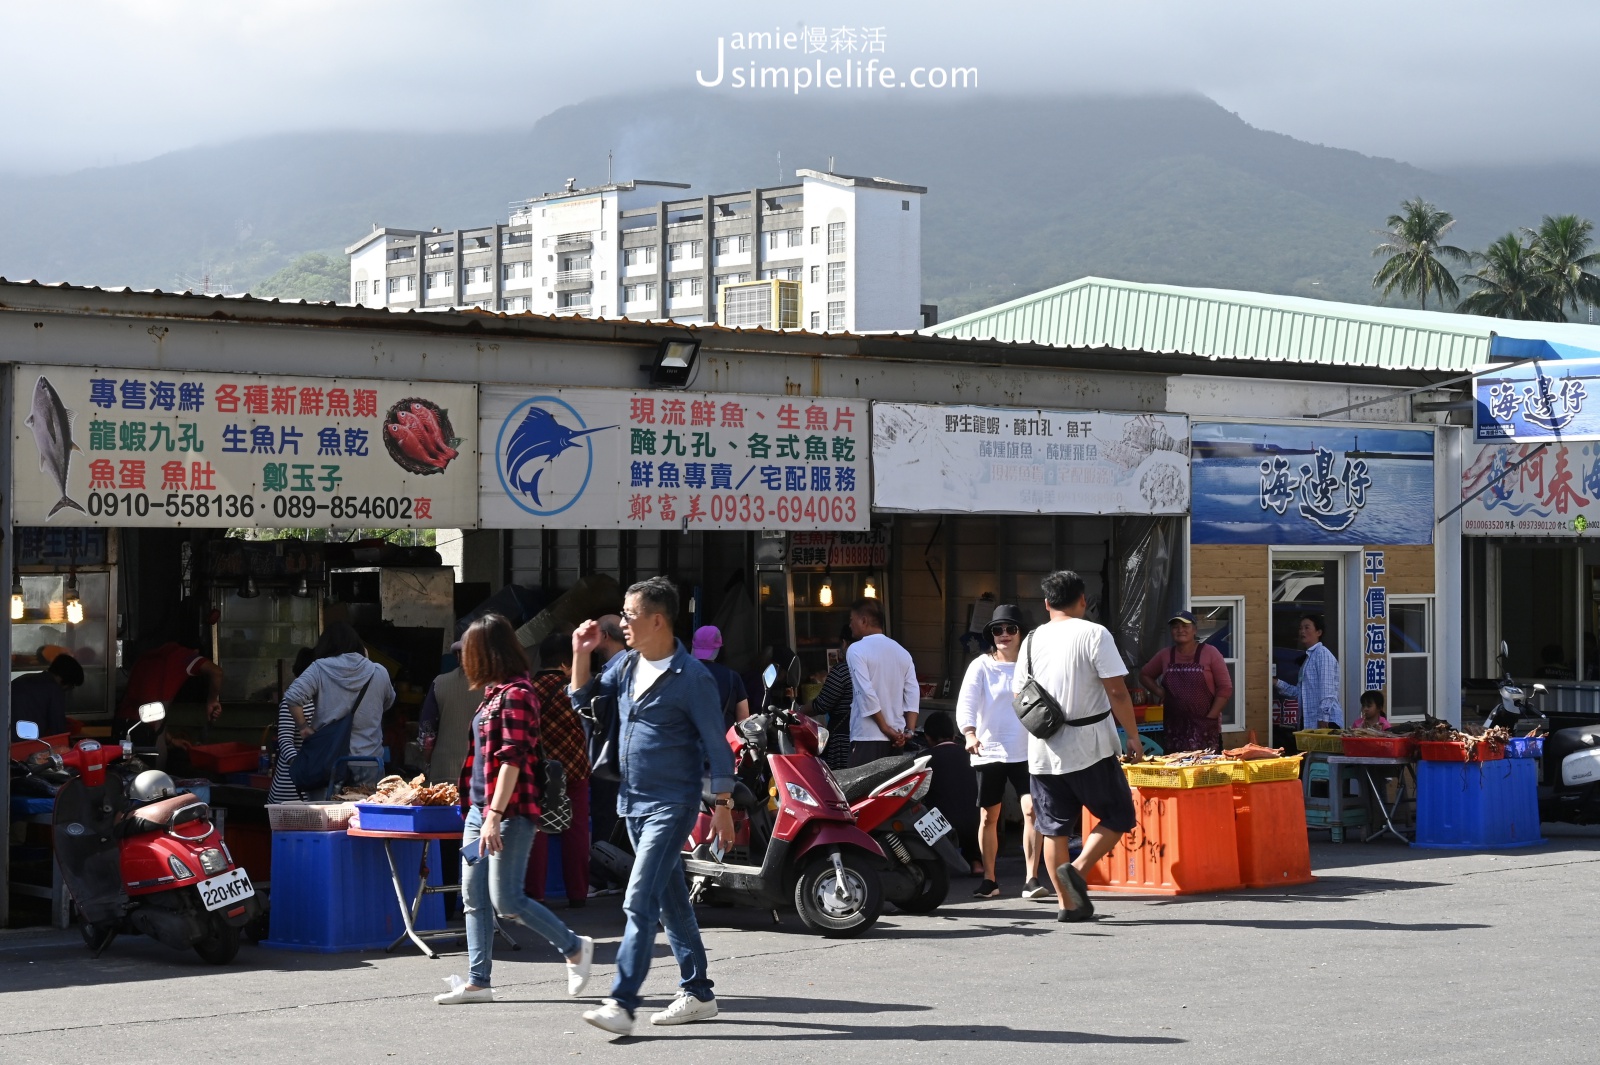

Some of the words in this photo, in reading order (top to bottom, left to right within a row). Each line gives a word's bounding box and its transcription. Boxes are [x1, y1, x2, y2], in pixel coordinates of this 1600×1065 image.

[88, 378, 205, 413] 專售海鮮
[214, 383, 378, 419] 各種新鮮魚類
[629, 397, 857, 433] 現流鮮魚、生魚片
[88, 420, 205, 454] 龍蝦九孔
[221, 424, 304, 456] 生魚片
[316, 426, 370, 457] 魚乾
[629, 427, 857, 463] 醃九孔、各式魚乾
[88, 458, 147, 491] 魚蛋
[160, 460, 216, 492] 魚肚
[262, 462, 343, 493] 鄭玉子
[1365, 551, 1386, 690] 平價海鮮
[203, 876, 252, 907] 220-KFM
